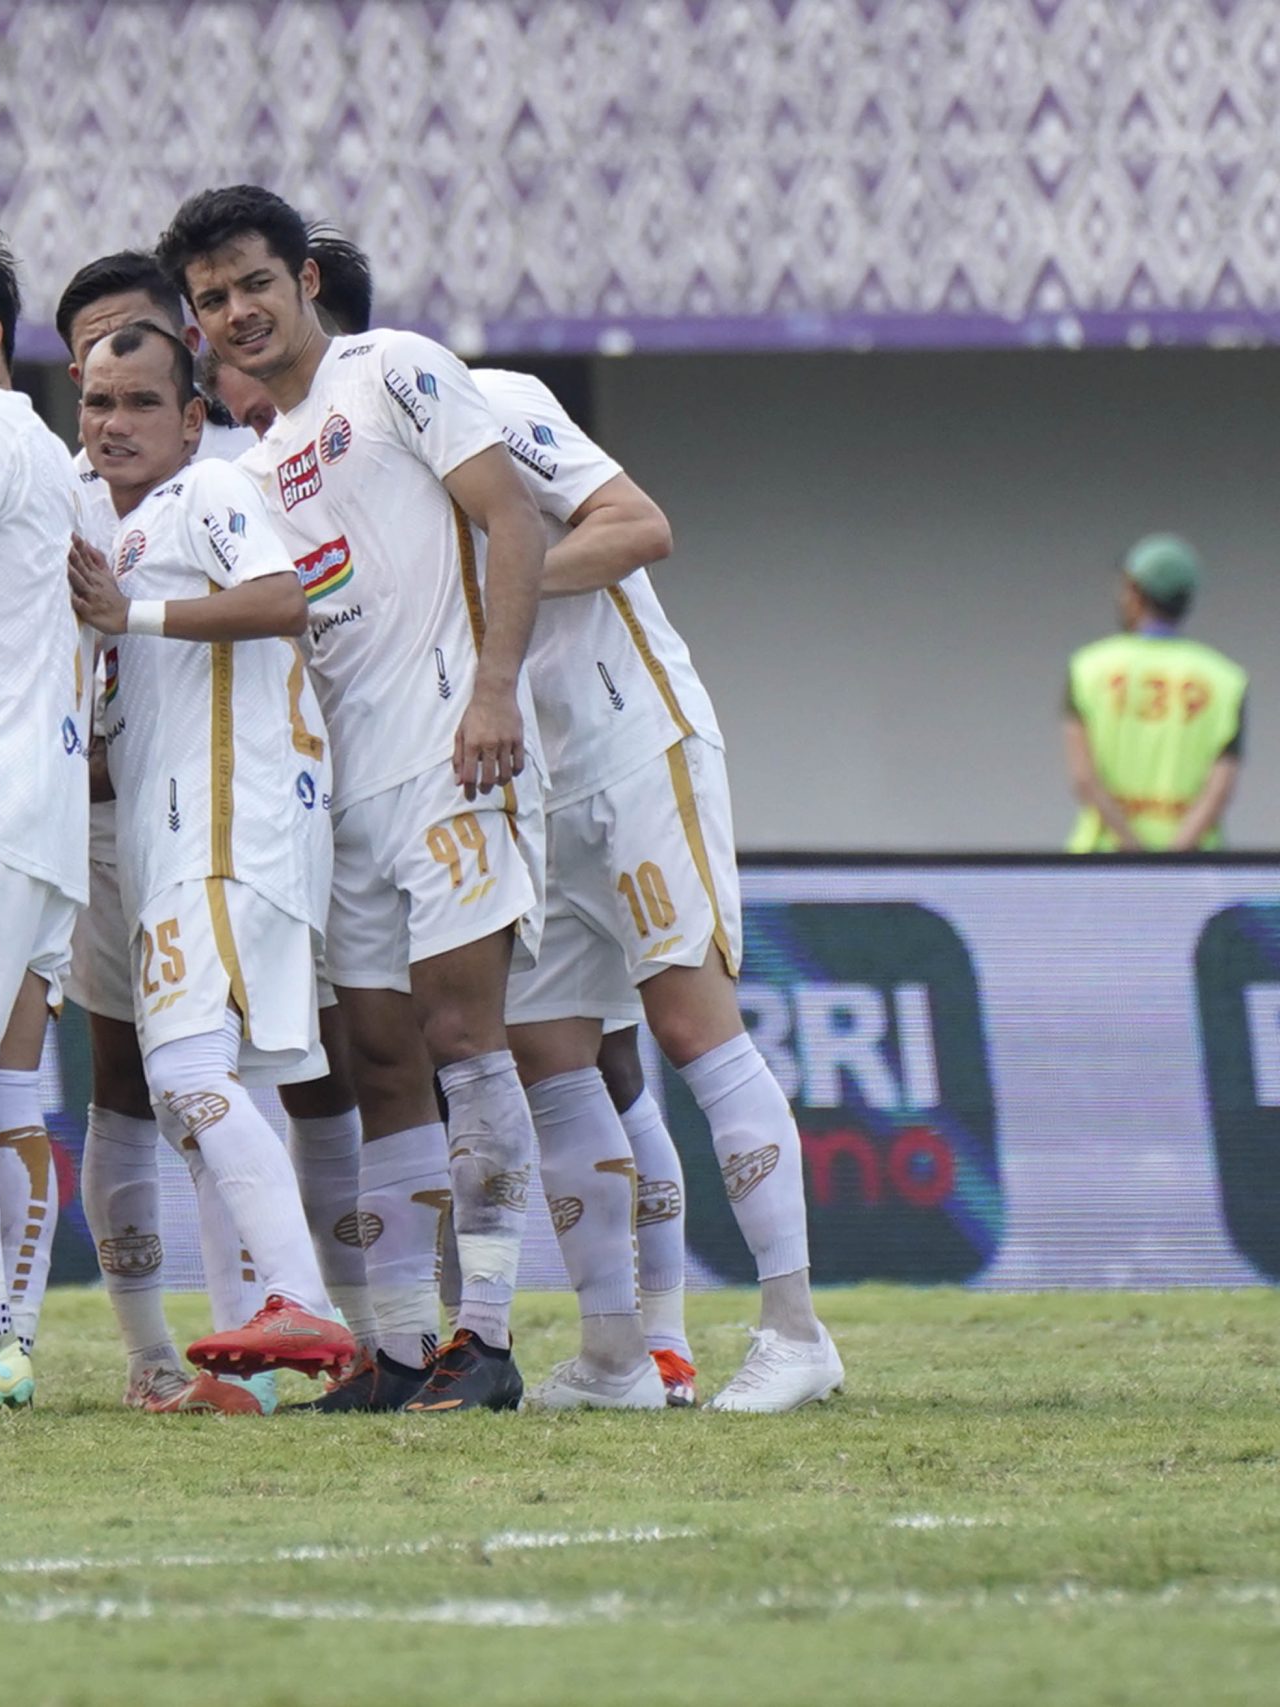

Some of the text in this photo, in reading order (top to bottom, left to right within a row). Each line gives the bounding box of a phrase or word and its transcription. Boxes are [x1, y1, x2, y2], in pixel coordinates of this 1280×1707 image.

[386, 368, 431, 428] ITHACA
[501, 426, 558, 475] ITHACA
[1109, 671, 1211, 723] 139
[426, 813, 488, 889] 99
[618, 861, 678, 939] 10
[142, 918, 186, 999] 25
